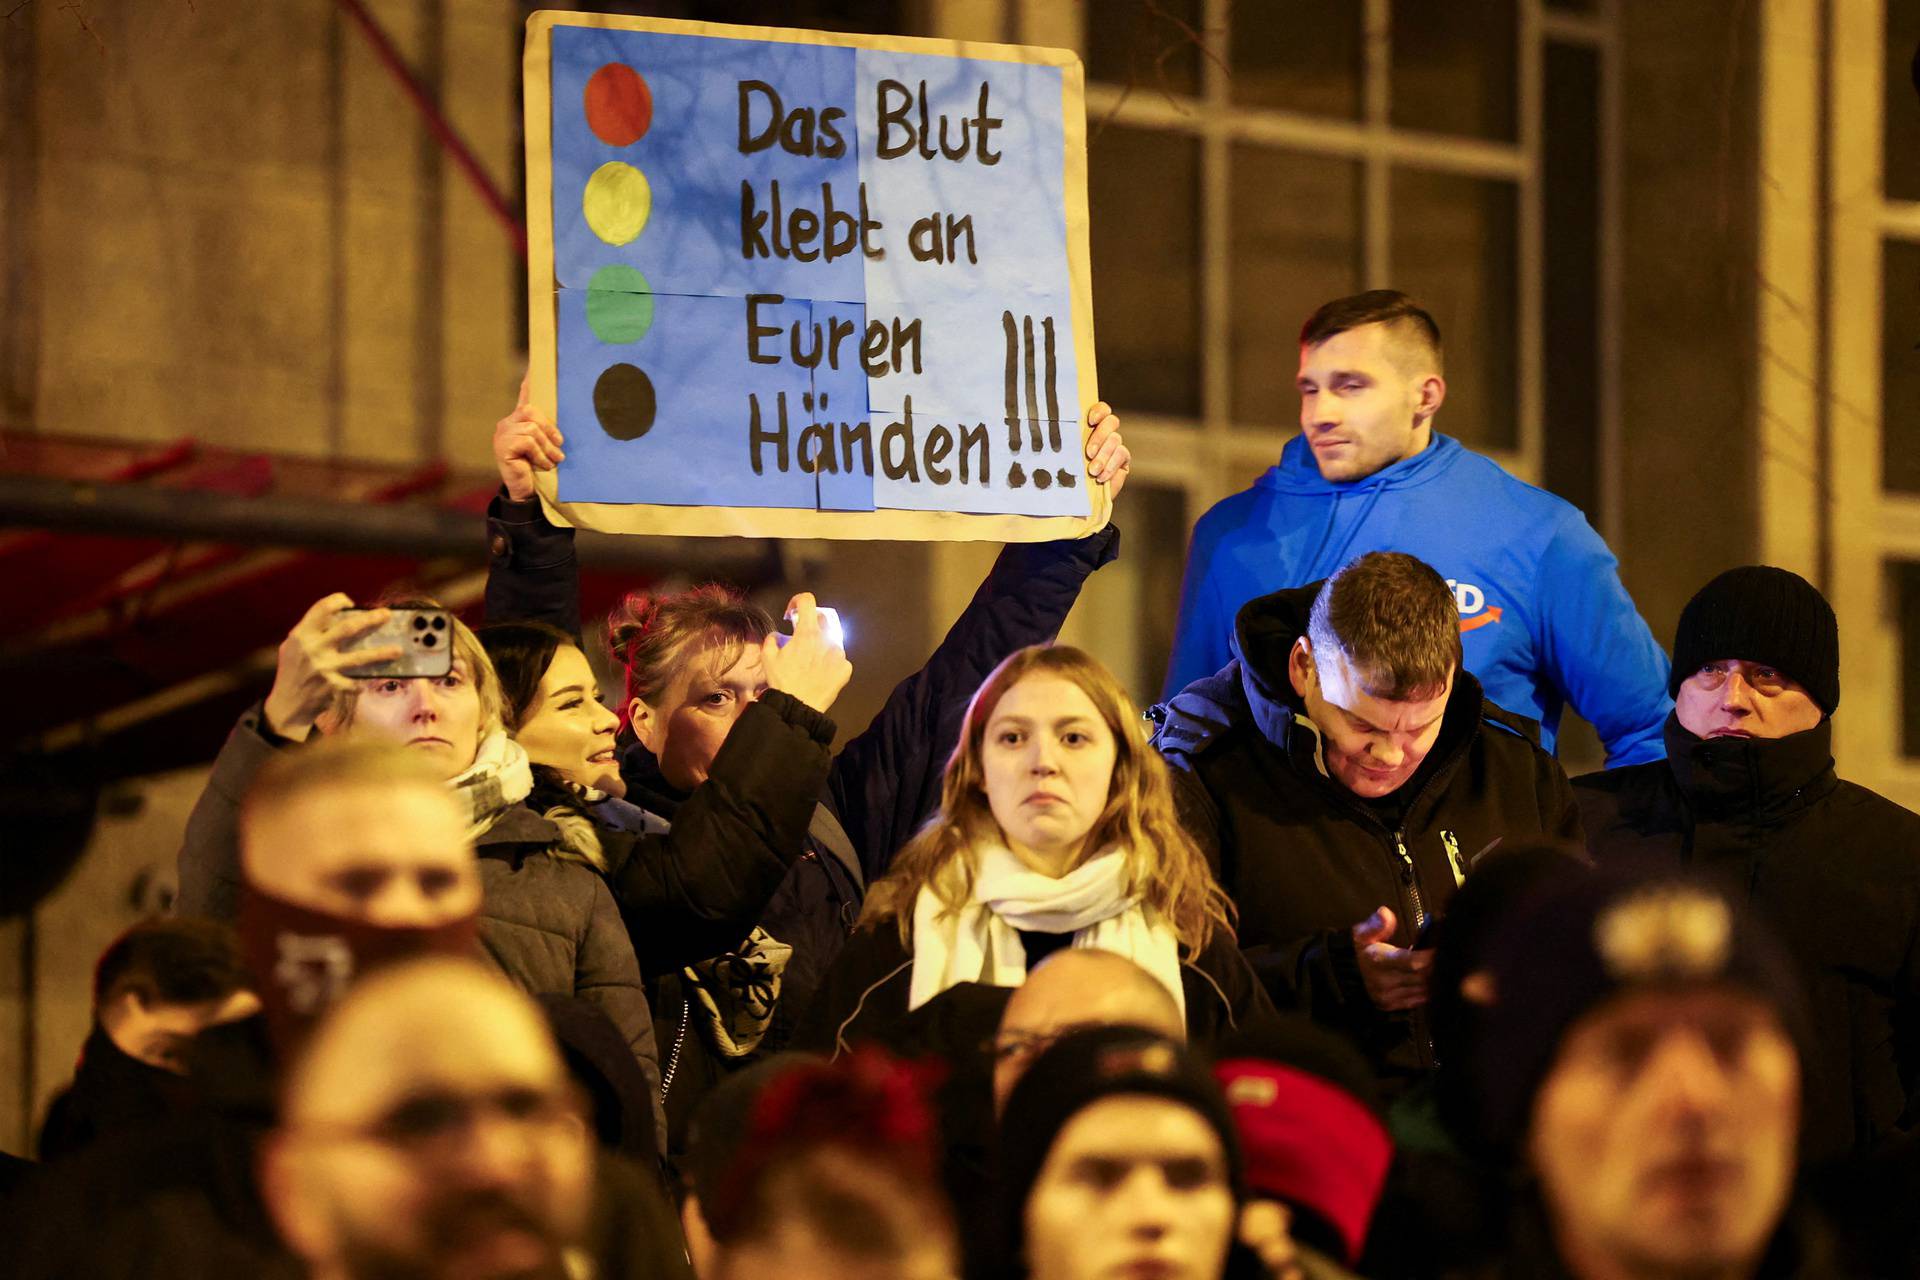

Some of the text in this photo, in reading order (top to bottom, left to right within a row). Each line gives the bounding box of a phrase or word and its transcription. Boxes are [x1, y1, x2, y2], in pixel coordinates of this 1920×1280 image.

[737, 79, 1004, 166] Das Blut
[740, 179, 978, 265] klebt an
[745, 293, 923, 378] Euren
